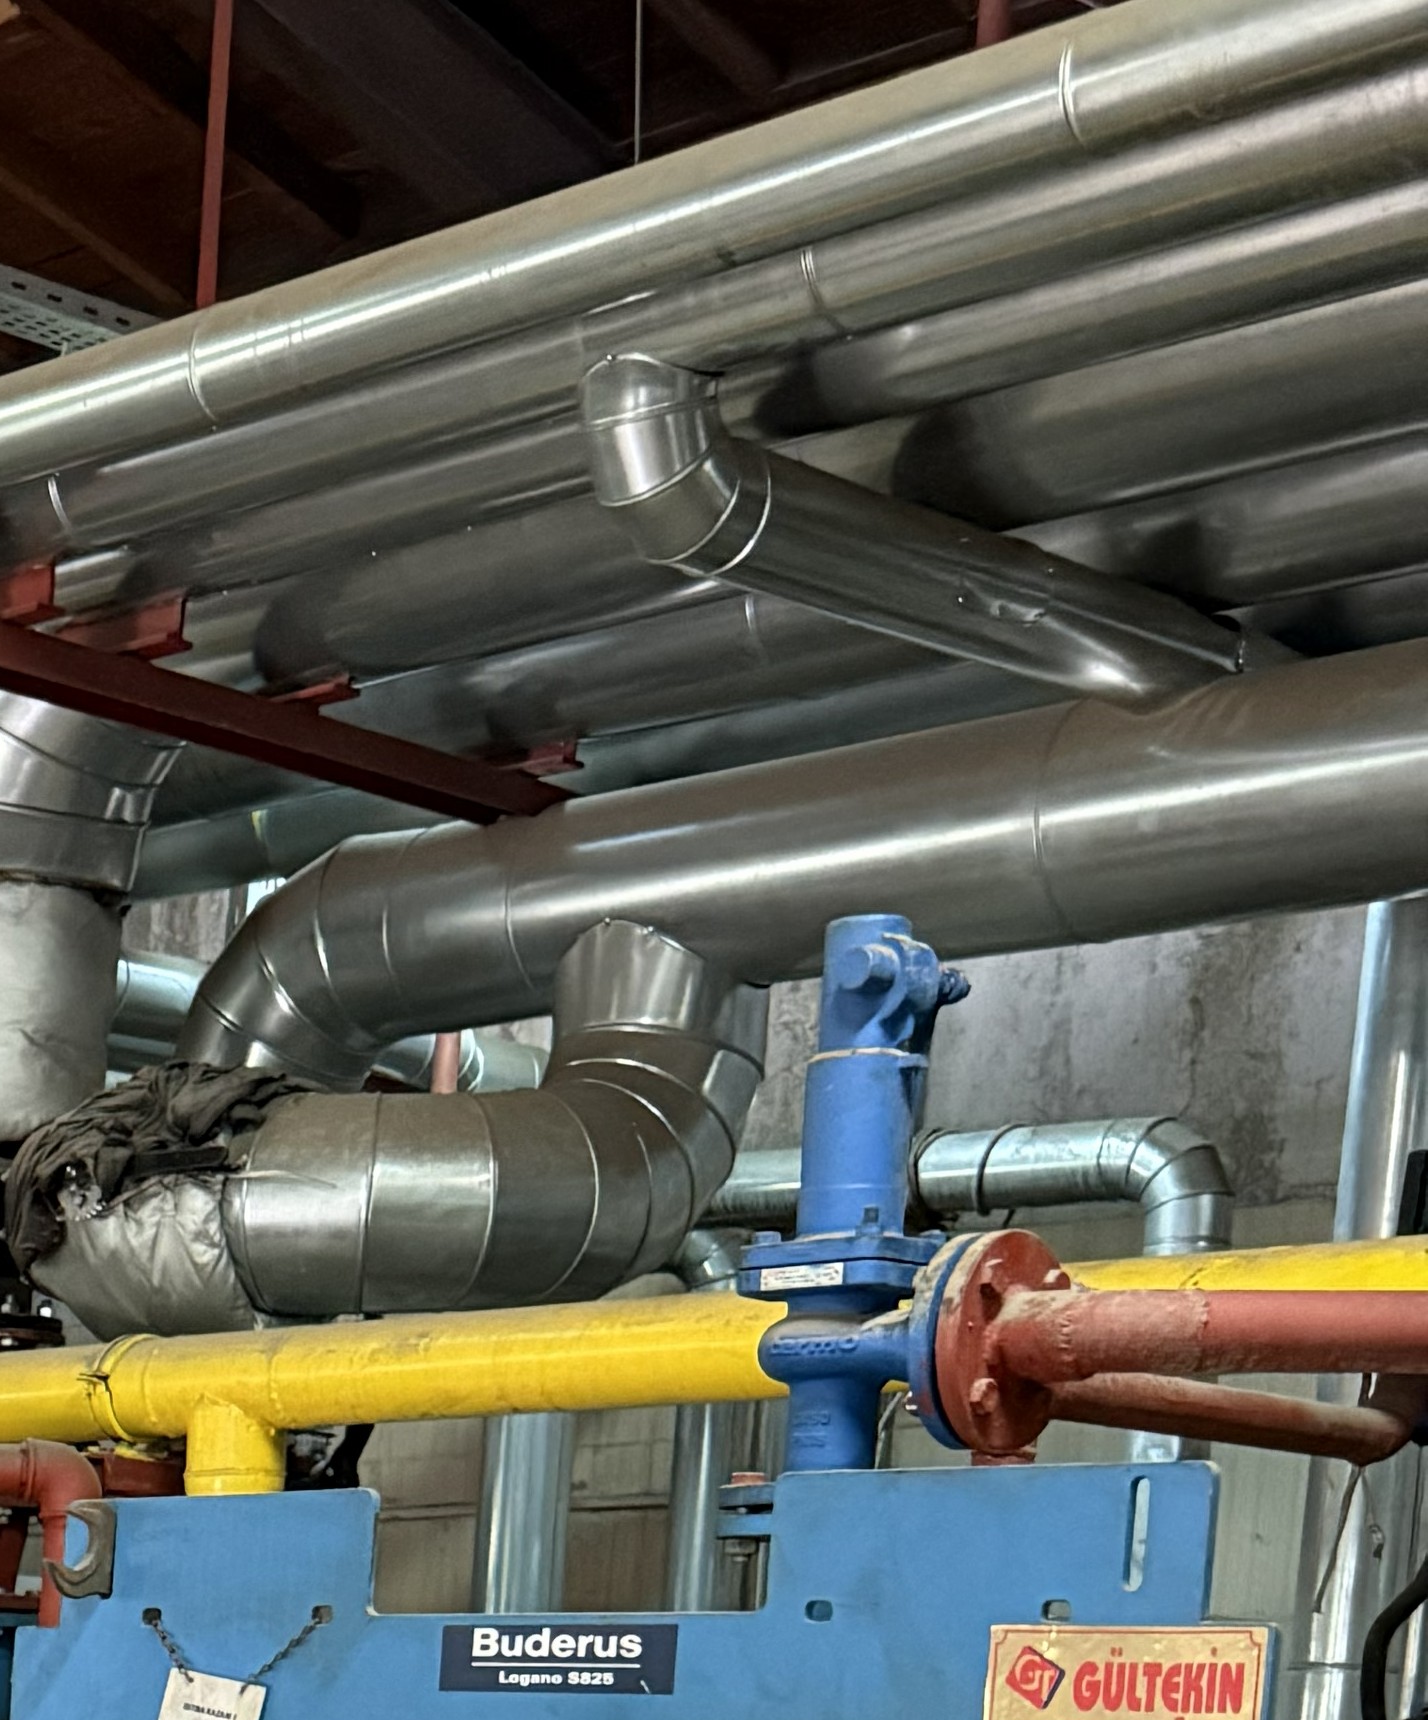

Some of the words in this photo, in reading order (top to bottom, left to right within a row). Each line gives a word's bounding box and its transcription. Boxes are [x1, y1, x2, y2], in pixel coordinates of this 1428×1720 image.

[471, 1627, 643, 1659] Buderus
[498, 1670, 563, 1687] Logano
[568, 1671, 615, 1685] S825
[1072, 1646, 1246, 1714] GÜLTEKİN
